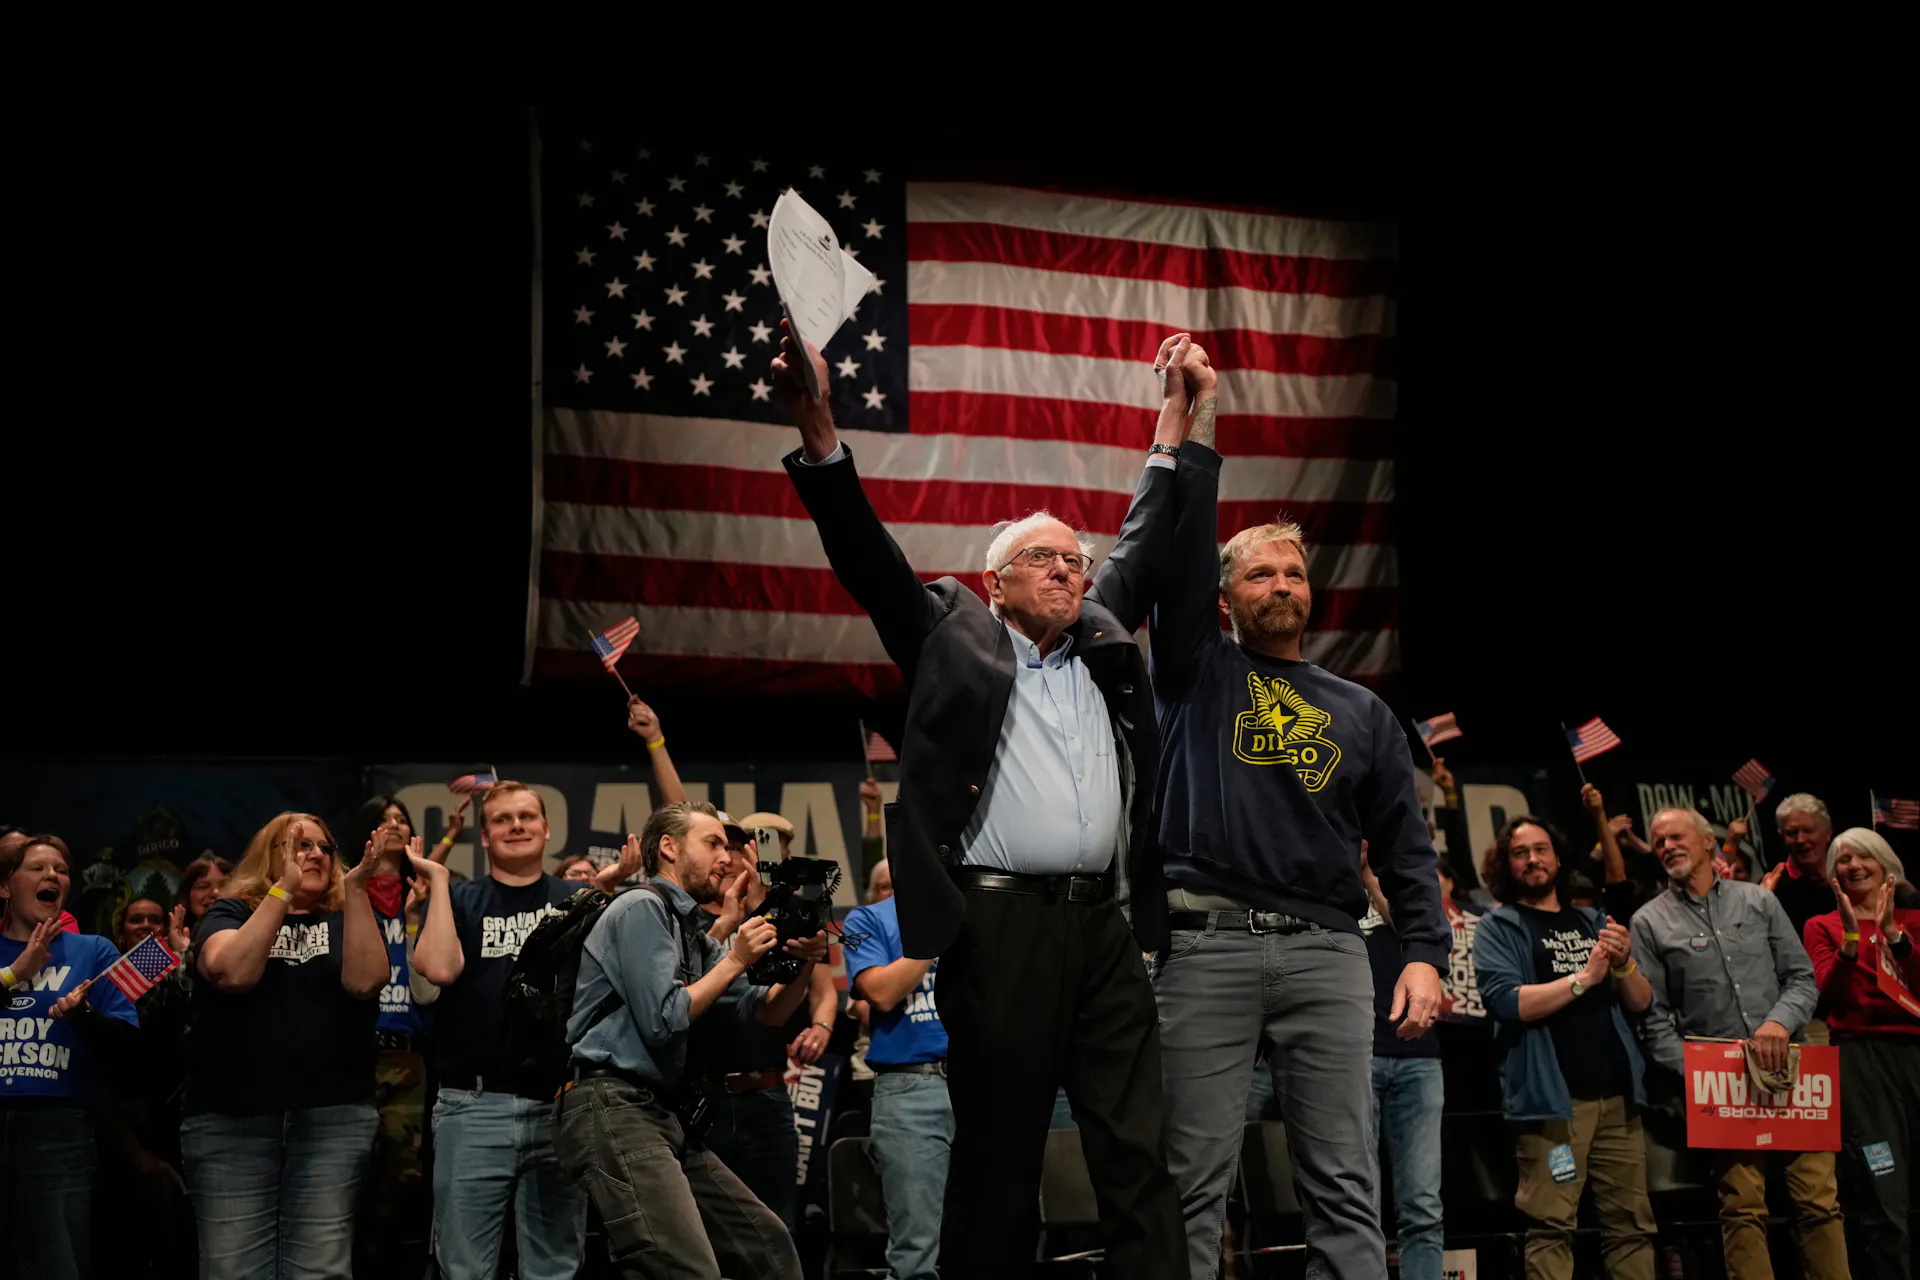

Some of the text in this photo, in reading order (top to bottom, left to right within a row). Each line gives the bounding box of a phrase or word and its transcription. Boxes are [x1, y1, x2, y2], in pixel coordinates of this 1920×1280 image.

[137, 839, 180, 856] DIRIGO
[1447, 907, 1470, 1015] MONEY
[11, 998, 29, 1007] FOR
[910, 1012, 933, 1024] FOR
[0, 1042, 71, 1070] KSON
[796, 1063, 827, 1112] BUY
[1700, 1106, 1829, 1121] EDUCATORS for
